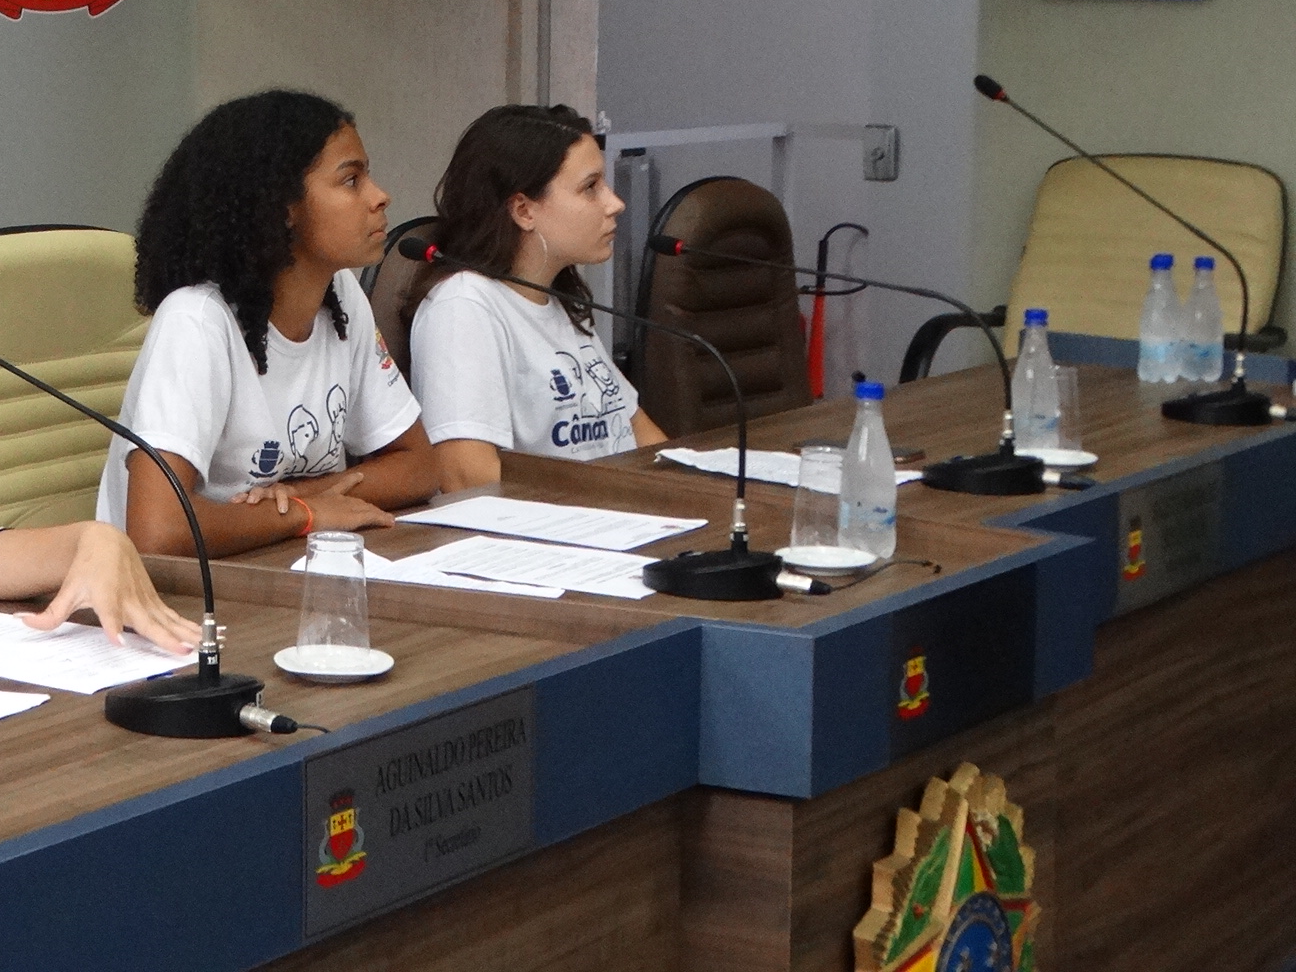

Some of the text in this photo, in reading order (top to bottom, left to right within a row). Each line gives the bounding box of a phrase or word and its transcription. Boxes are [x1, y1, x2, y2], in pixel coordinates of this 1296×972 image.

[376, 717, 527, 796] AGUINALDO PEREIRA
[389, 764, 513, 837] DA SILVA SANTOS
